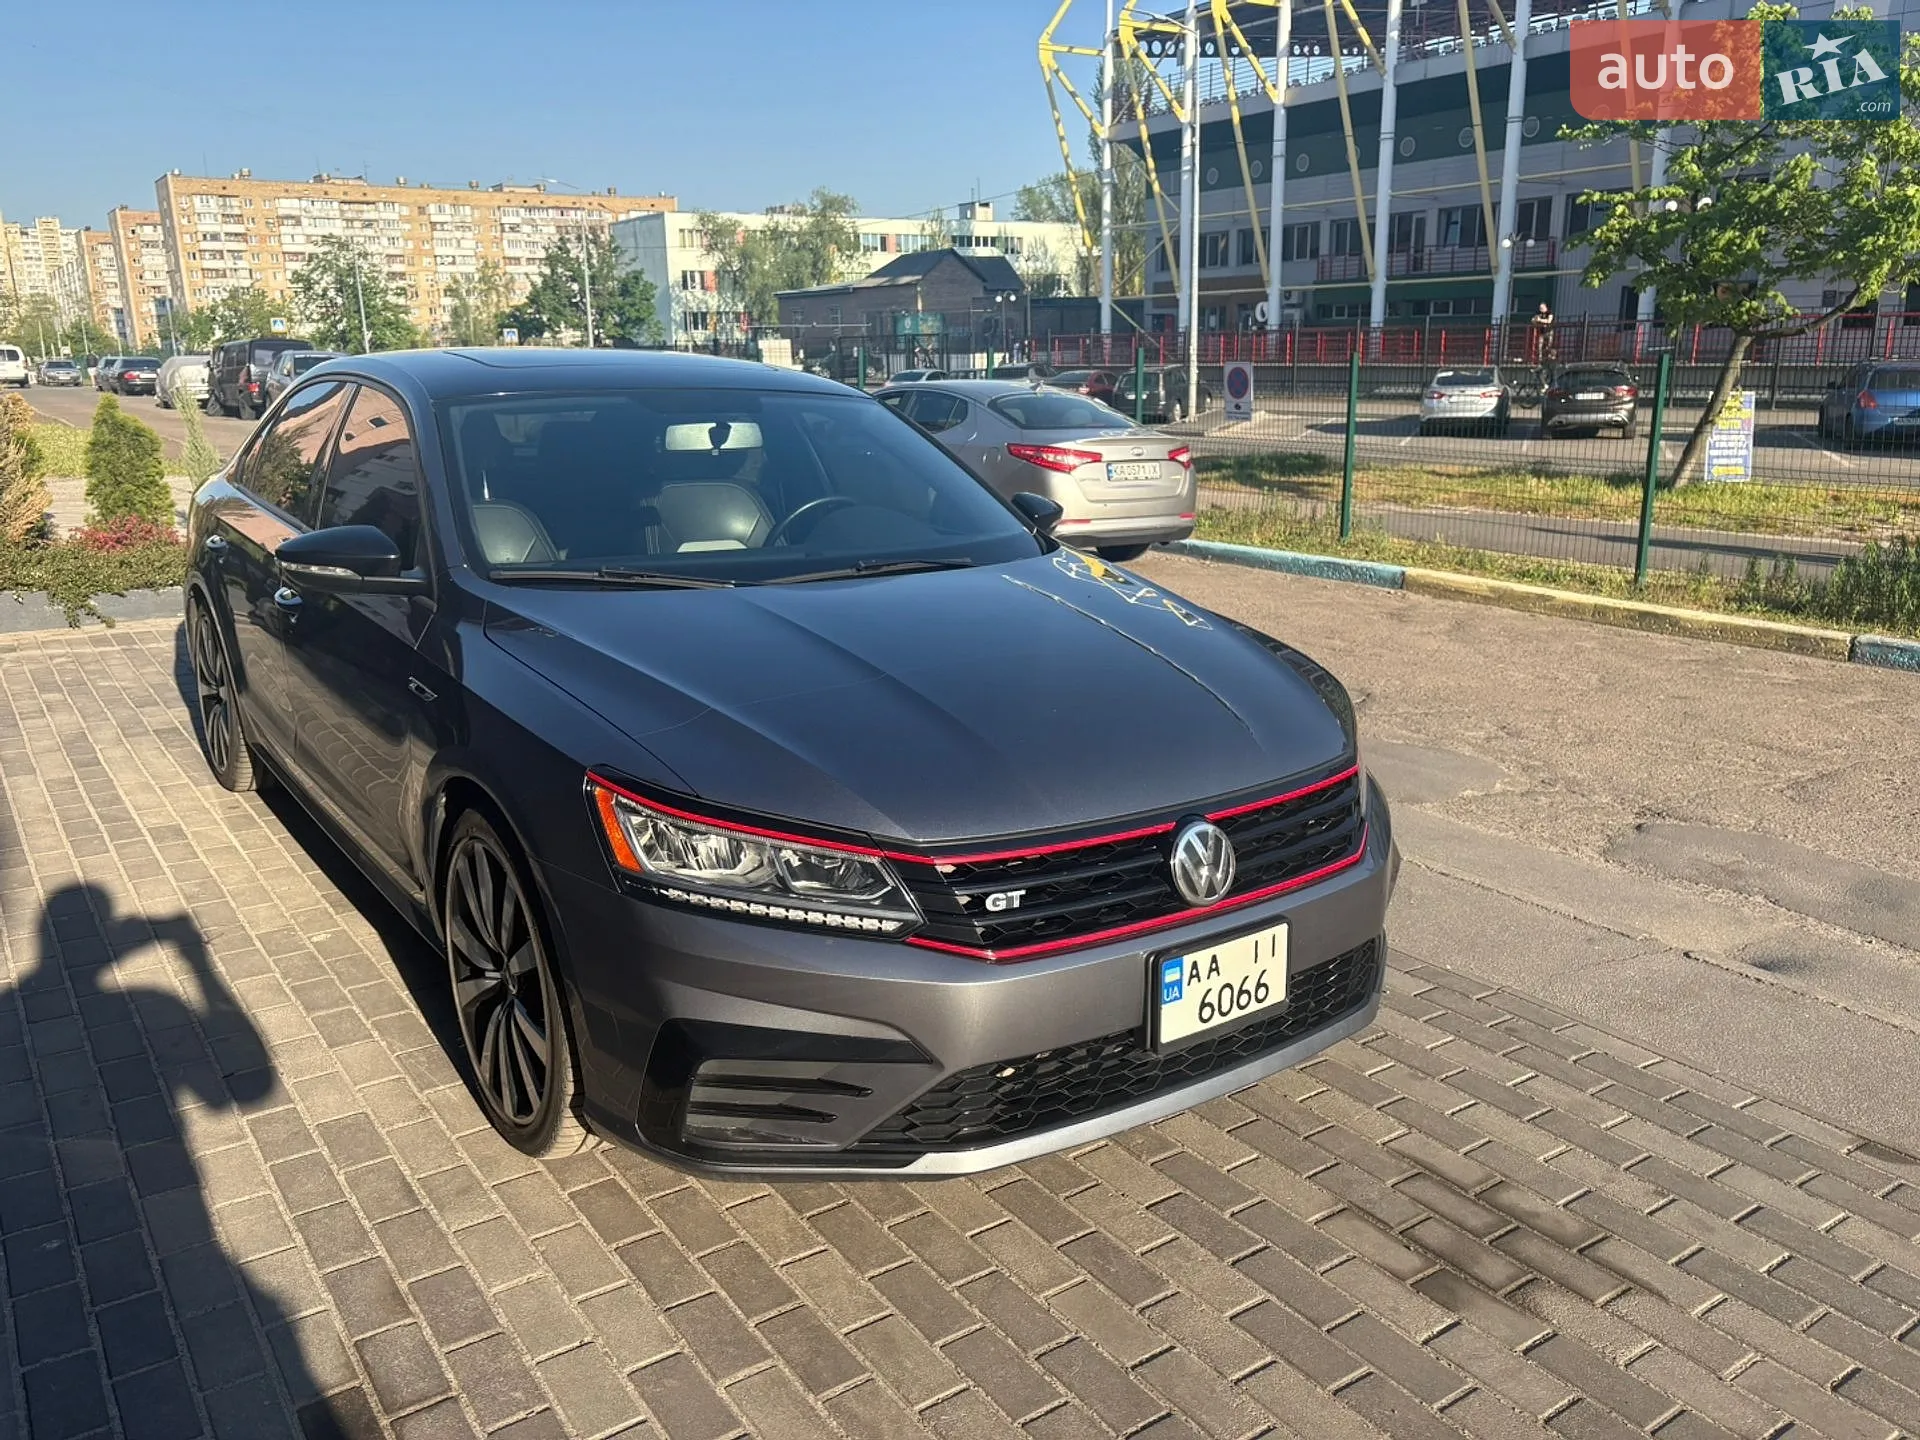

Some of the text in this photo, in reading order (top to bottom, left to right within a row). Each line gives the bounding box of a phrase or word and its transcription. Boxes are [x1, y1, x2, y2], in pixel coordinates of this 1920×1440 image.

[985, 889, 1026, 912] GT
[1187, 954, 1220, 986] AA
[1164, 985, 1180, 1001] UA
[1198, 968, 1269, 1024] 6066
